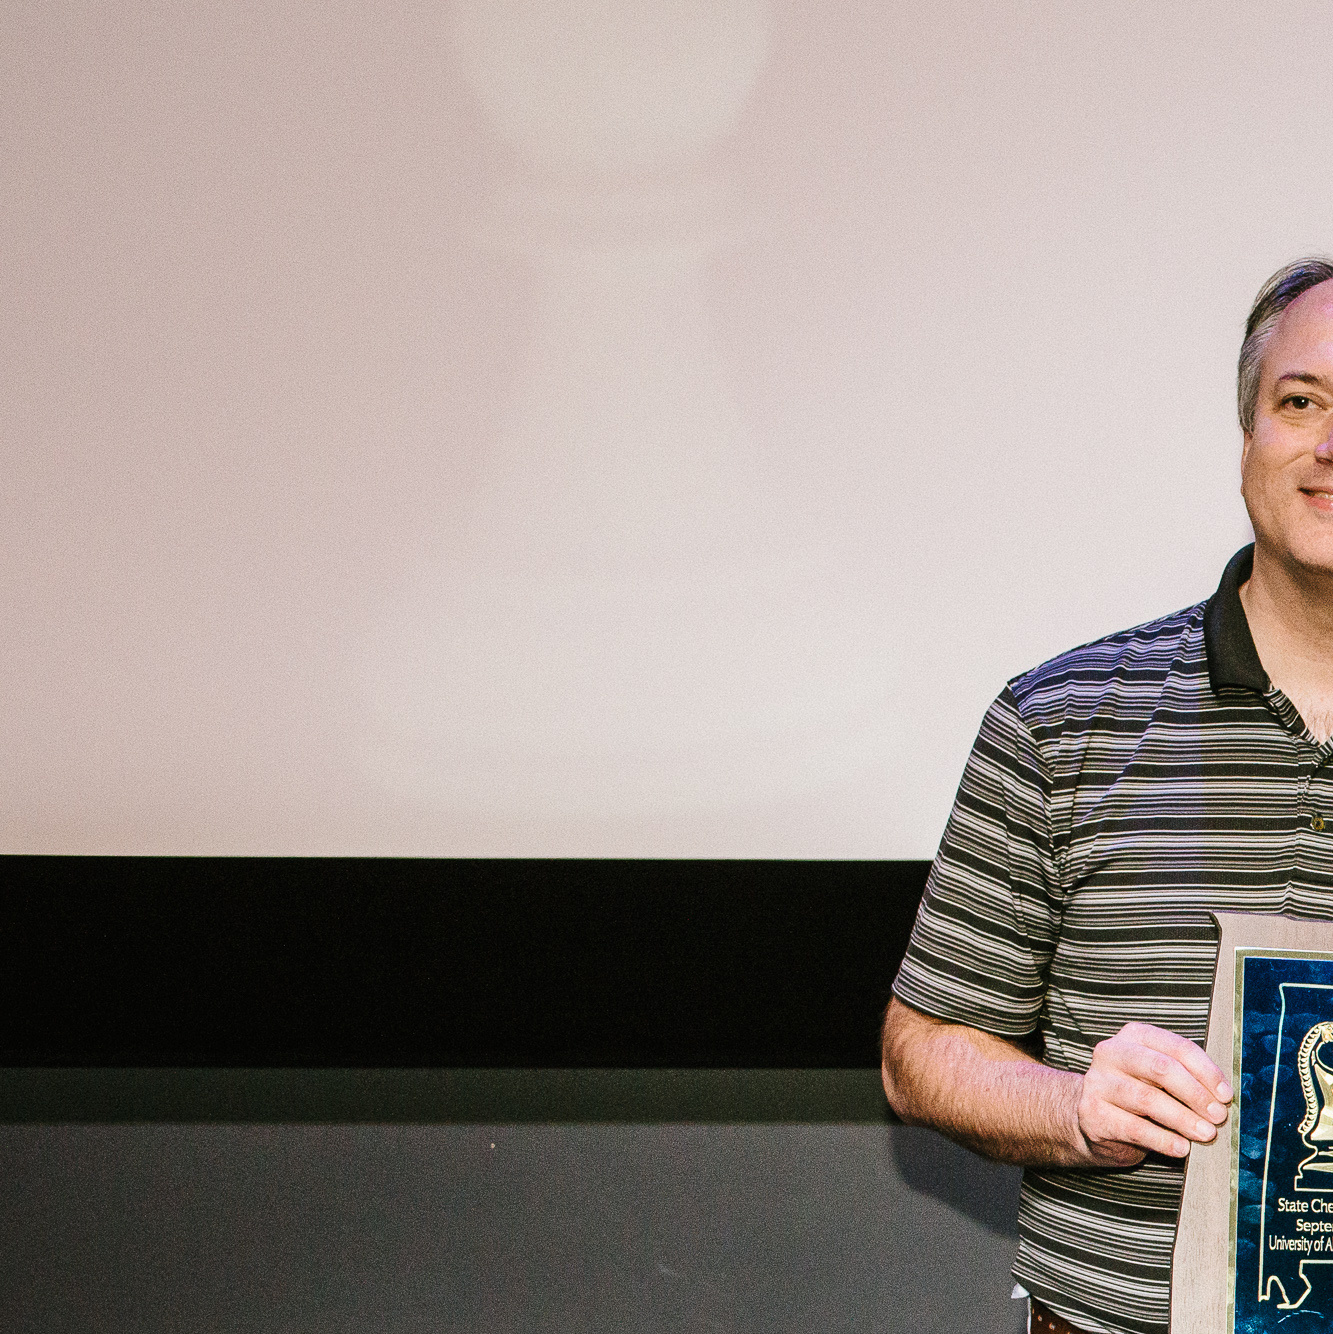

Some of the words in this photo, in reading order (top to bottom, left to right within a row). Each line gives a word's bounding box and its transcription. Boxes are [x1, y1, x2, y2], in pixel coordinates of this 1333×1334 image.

[1277, 1198, 1309, 1213] State
[1268, 1235, 1313, 1256] University
[1313, 1236, 1325, 1251] of
